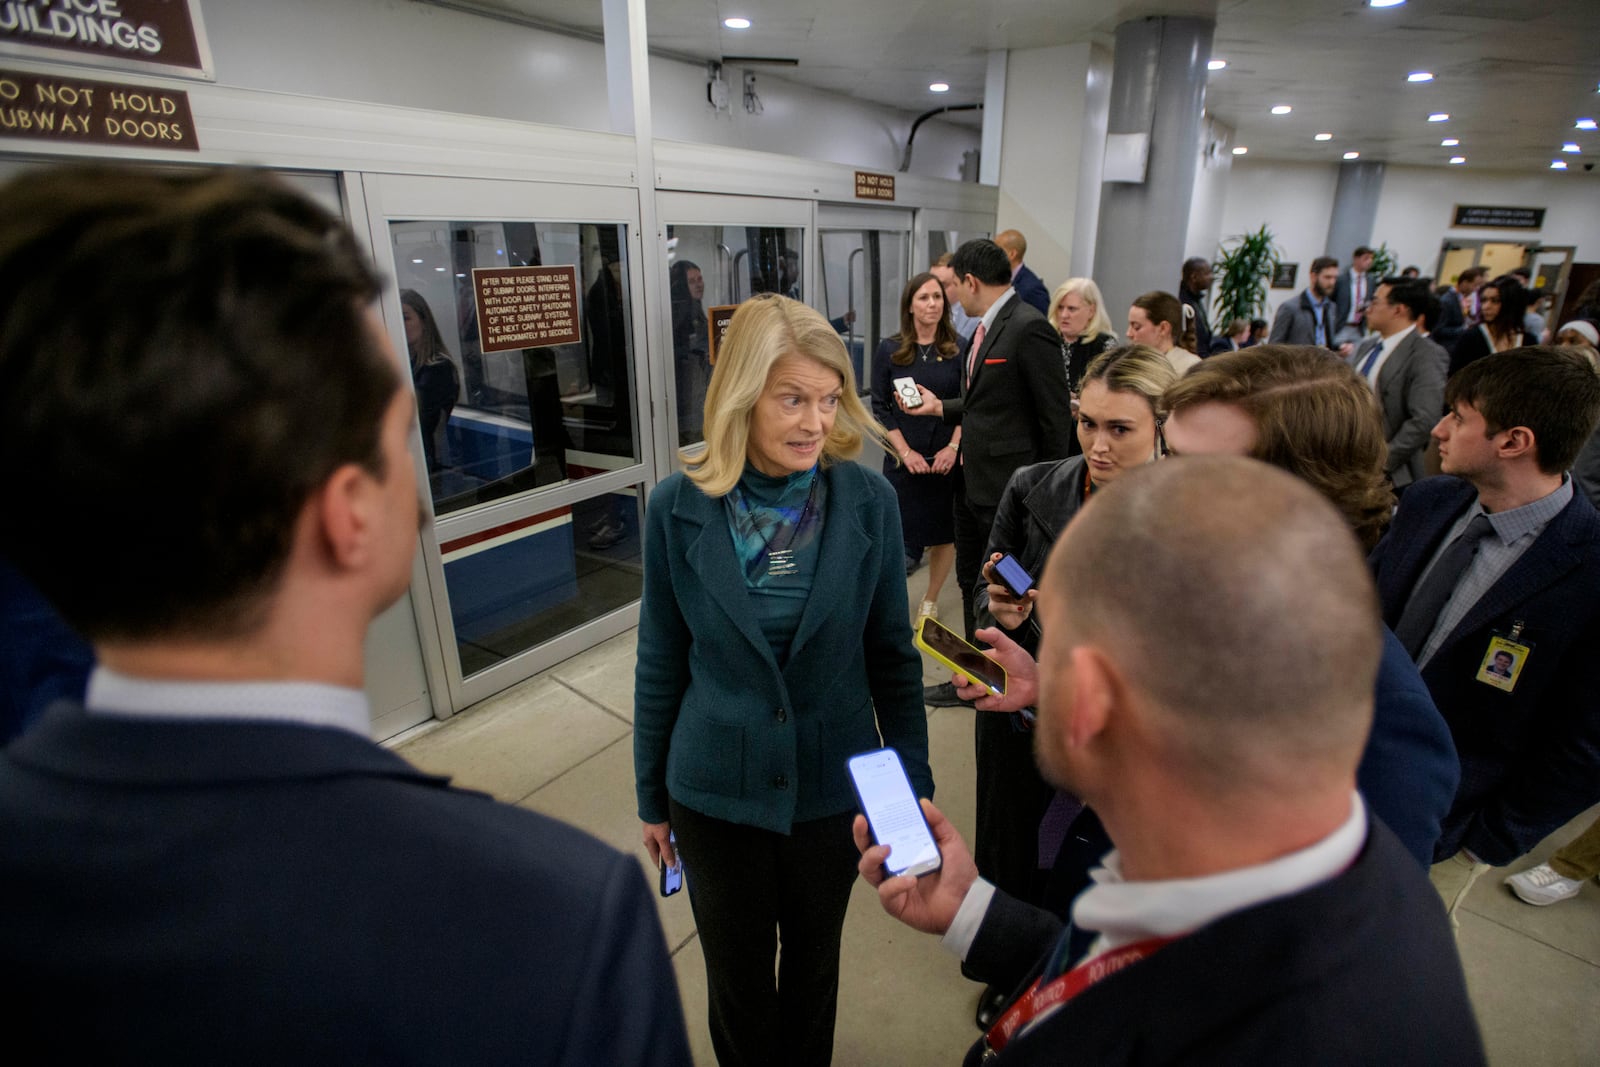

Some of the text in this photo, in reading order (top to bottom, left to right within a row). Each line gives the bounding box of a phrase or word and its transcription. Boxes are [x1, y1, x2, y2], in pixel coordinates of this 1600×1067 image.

[0, 3, 162, 53] UILDINGS
[0, 79, 176, 115] O NOT HOLD
[0, 107, 183, 141] UBWAY DOORS
[858, 174, 866, 184] DO
[868, 176, 878, 184] NOT
[482, 278, 500, 286] AFTER
[502, 276, 516, 284] TONE
[516, 276, 534, 284] PLEASE
[536, 274, 552, 282] STAND
[494, 286, 514, 294] SUBWAY
[538, 284, 570, 292] INTERFERING
[484, 298, 500, 306] WITH
[538, 294, 560, 302] INITIATE
[486, 306, 518, 314] AUTOMATIC
[542, 302, 572, 310] SHUTDOWN
[488, 316, 498, 324] OF
[516, 314, 542, 322] SUBWAY
[488, 326, 500, 334] THE
[502, 324, 520, 332] NEXT
[536, 320, 550, 328] WILL
[552, 318, 572, 326] ARRIVE
[496, 332, 538, 342] APPROXIMATELY
